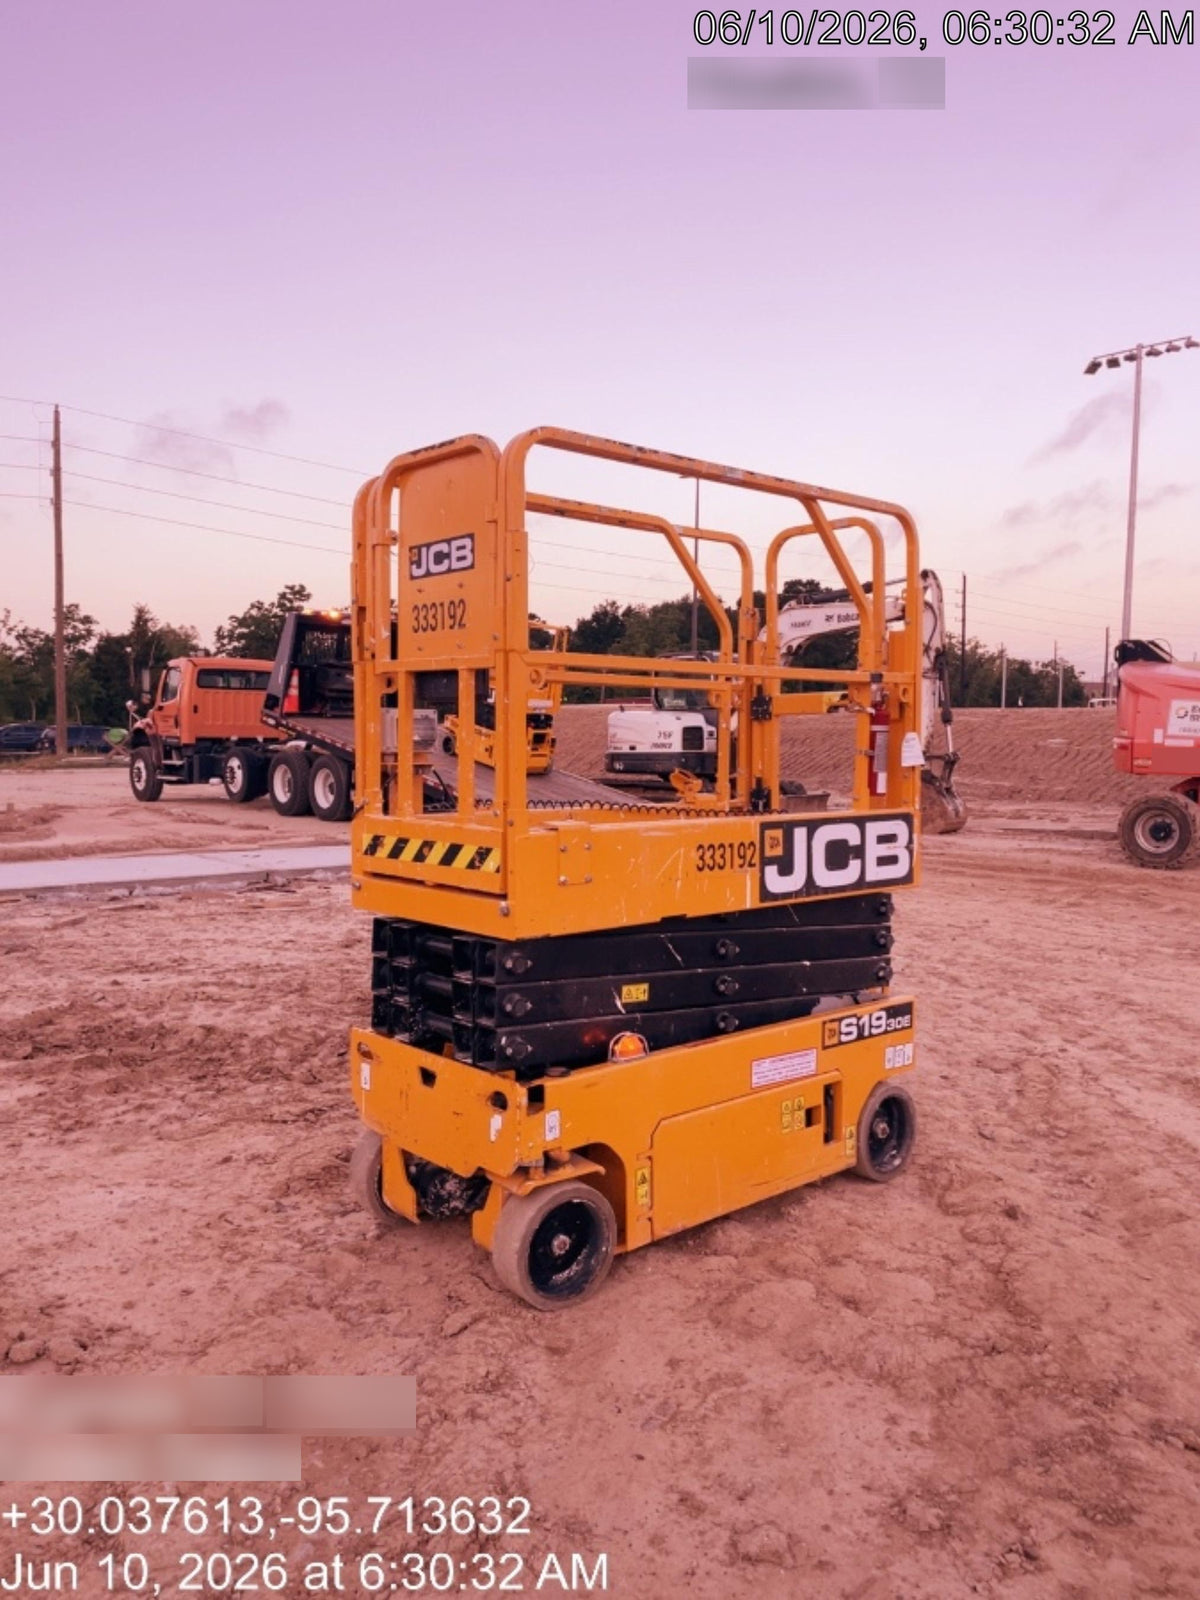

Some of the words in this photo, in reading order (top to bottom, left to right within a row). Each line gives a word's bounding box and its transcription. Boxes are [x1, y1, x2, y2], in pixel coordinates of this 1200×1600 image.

[410, 537, 474, 577] JCB
[412, 598, 466, 634] 333192
[696, 841, 756, 872] 333192
[764, 819, 911, 893] JCB
